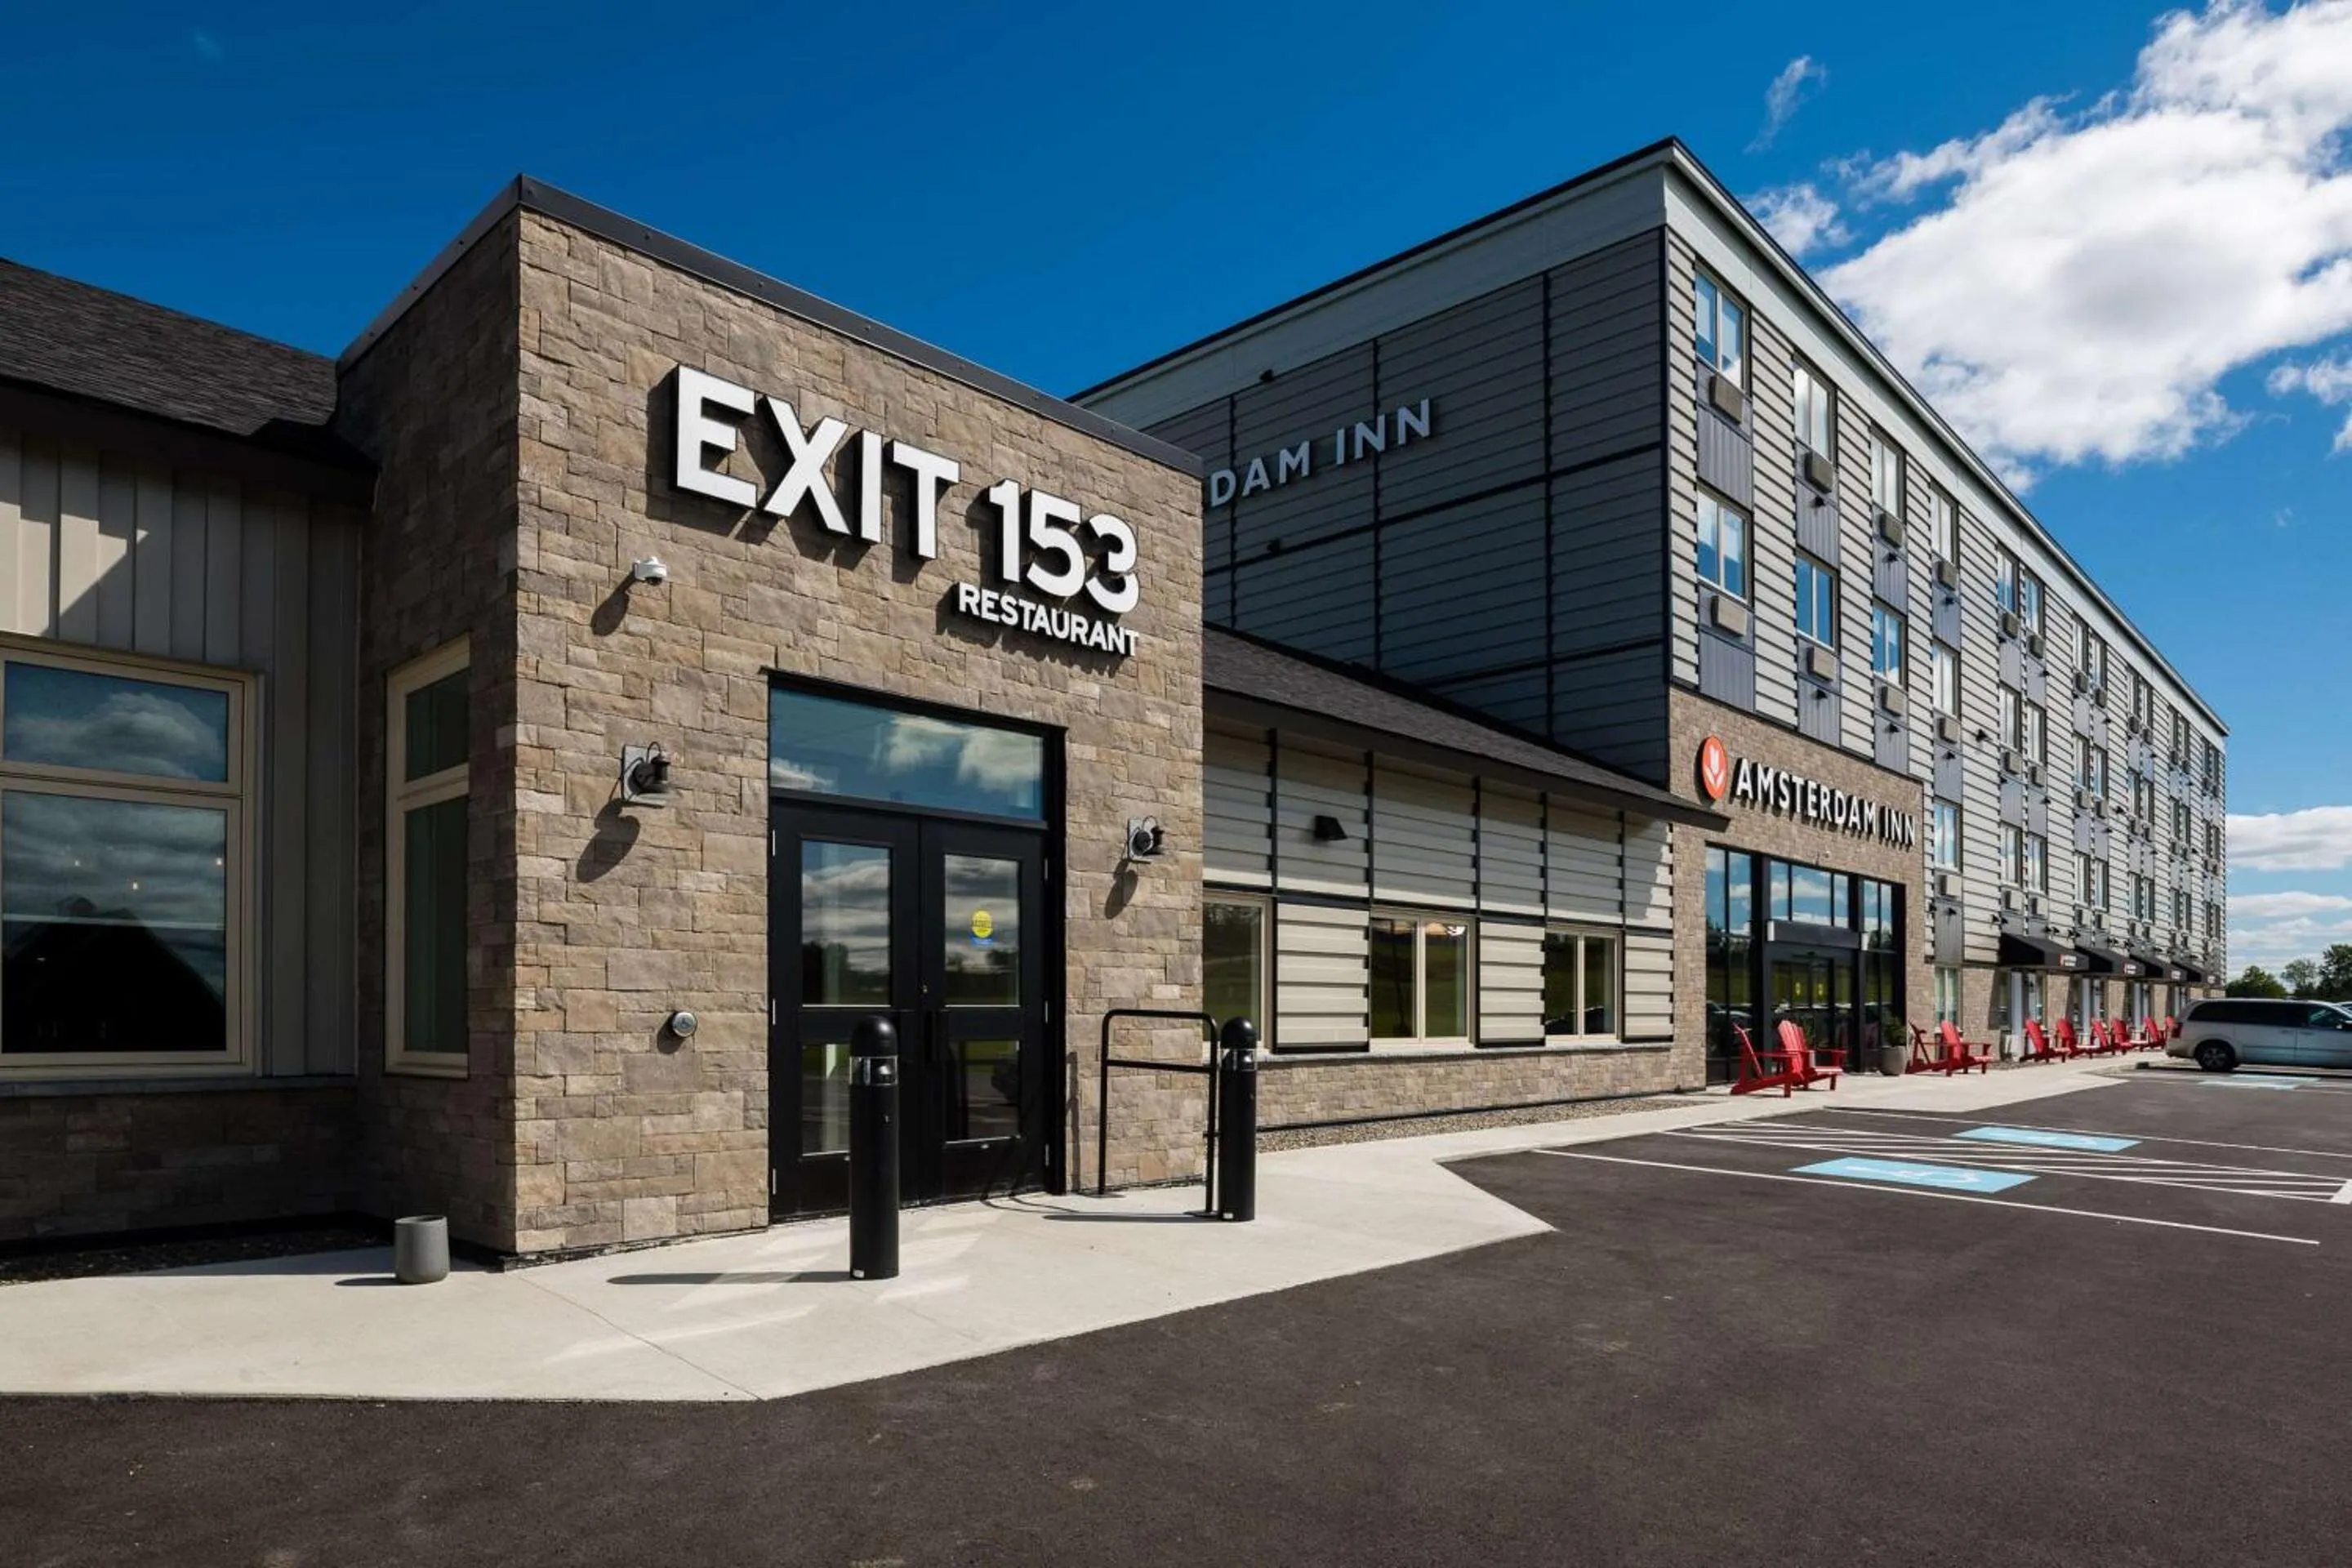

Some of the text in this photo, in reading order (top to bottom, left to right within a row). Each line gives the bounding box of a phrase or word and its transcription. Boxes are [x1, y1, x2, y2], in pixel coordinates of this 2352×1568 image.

[676, 365, 1141, 615] EXIT 153
[1210, 398, 1431, 508] DAM INN
[957, 582, 1141, 657] RESTAURANT
[1735, 757, 1916, 846] AMSTERDAM INN
